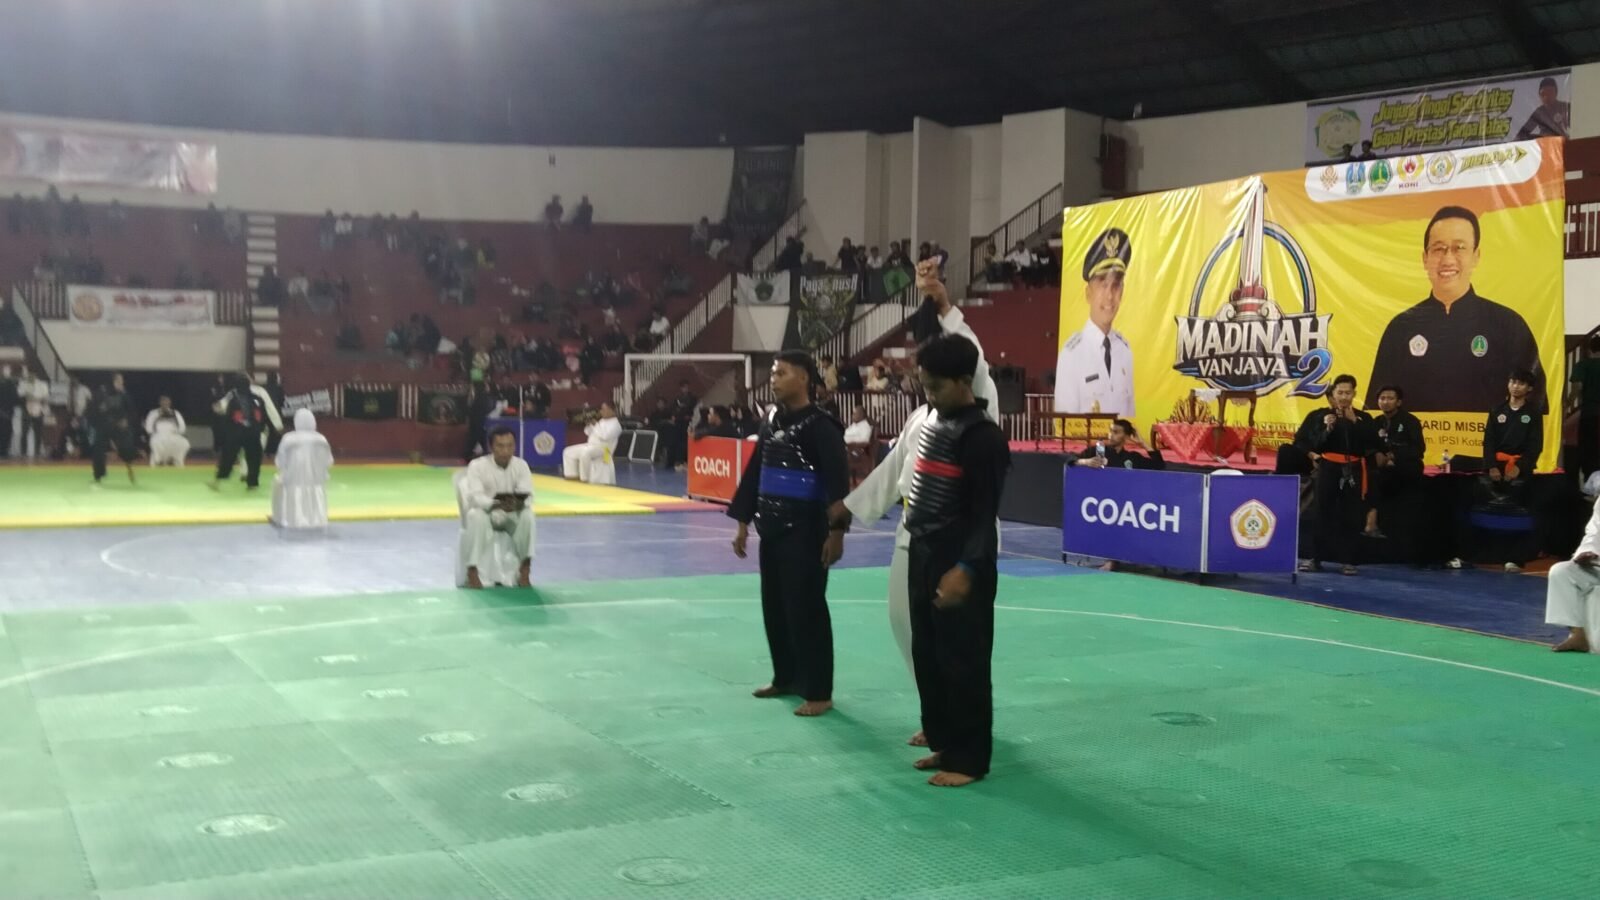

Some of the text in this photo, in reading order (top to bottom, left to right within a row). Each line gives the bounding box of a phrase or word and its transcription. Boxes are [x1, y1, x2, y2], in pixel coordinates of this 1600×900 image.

[1175, 313, 1333, 362] MADINAH
[1287, 348, 1333, 399] 2
[1421, 420, 1486, 433] ARID MISB
[1438, 436, 1459, 446] IPSI
[693, 455, 730, 478] COACH
[1081, 496, 1180, 534] COACH
